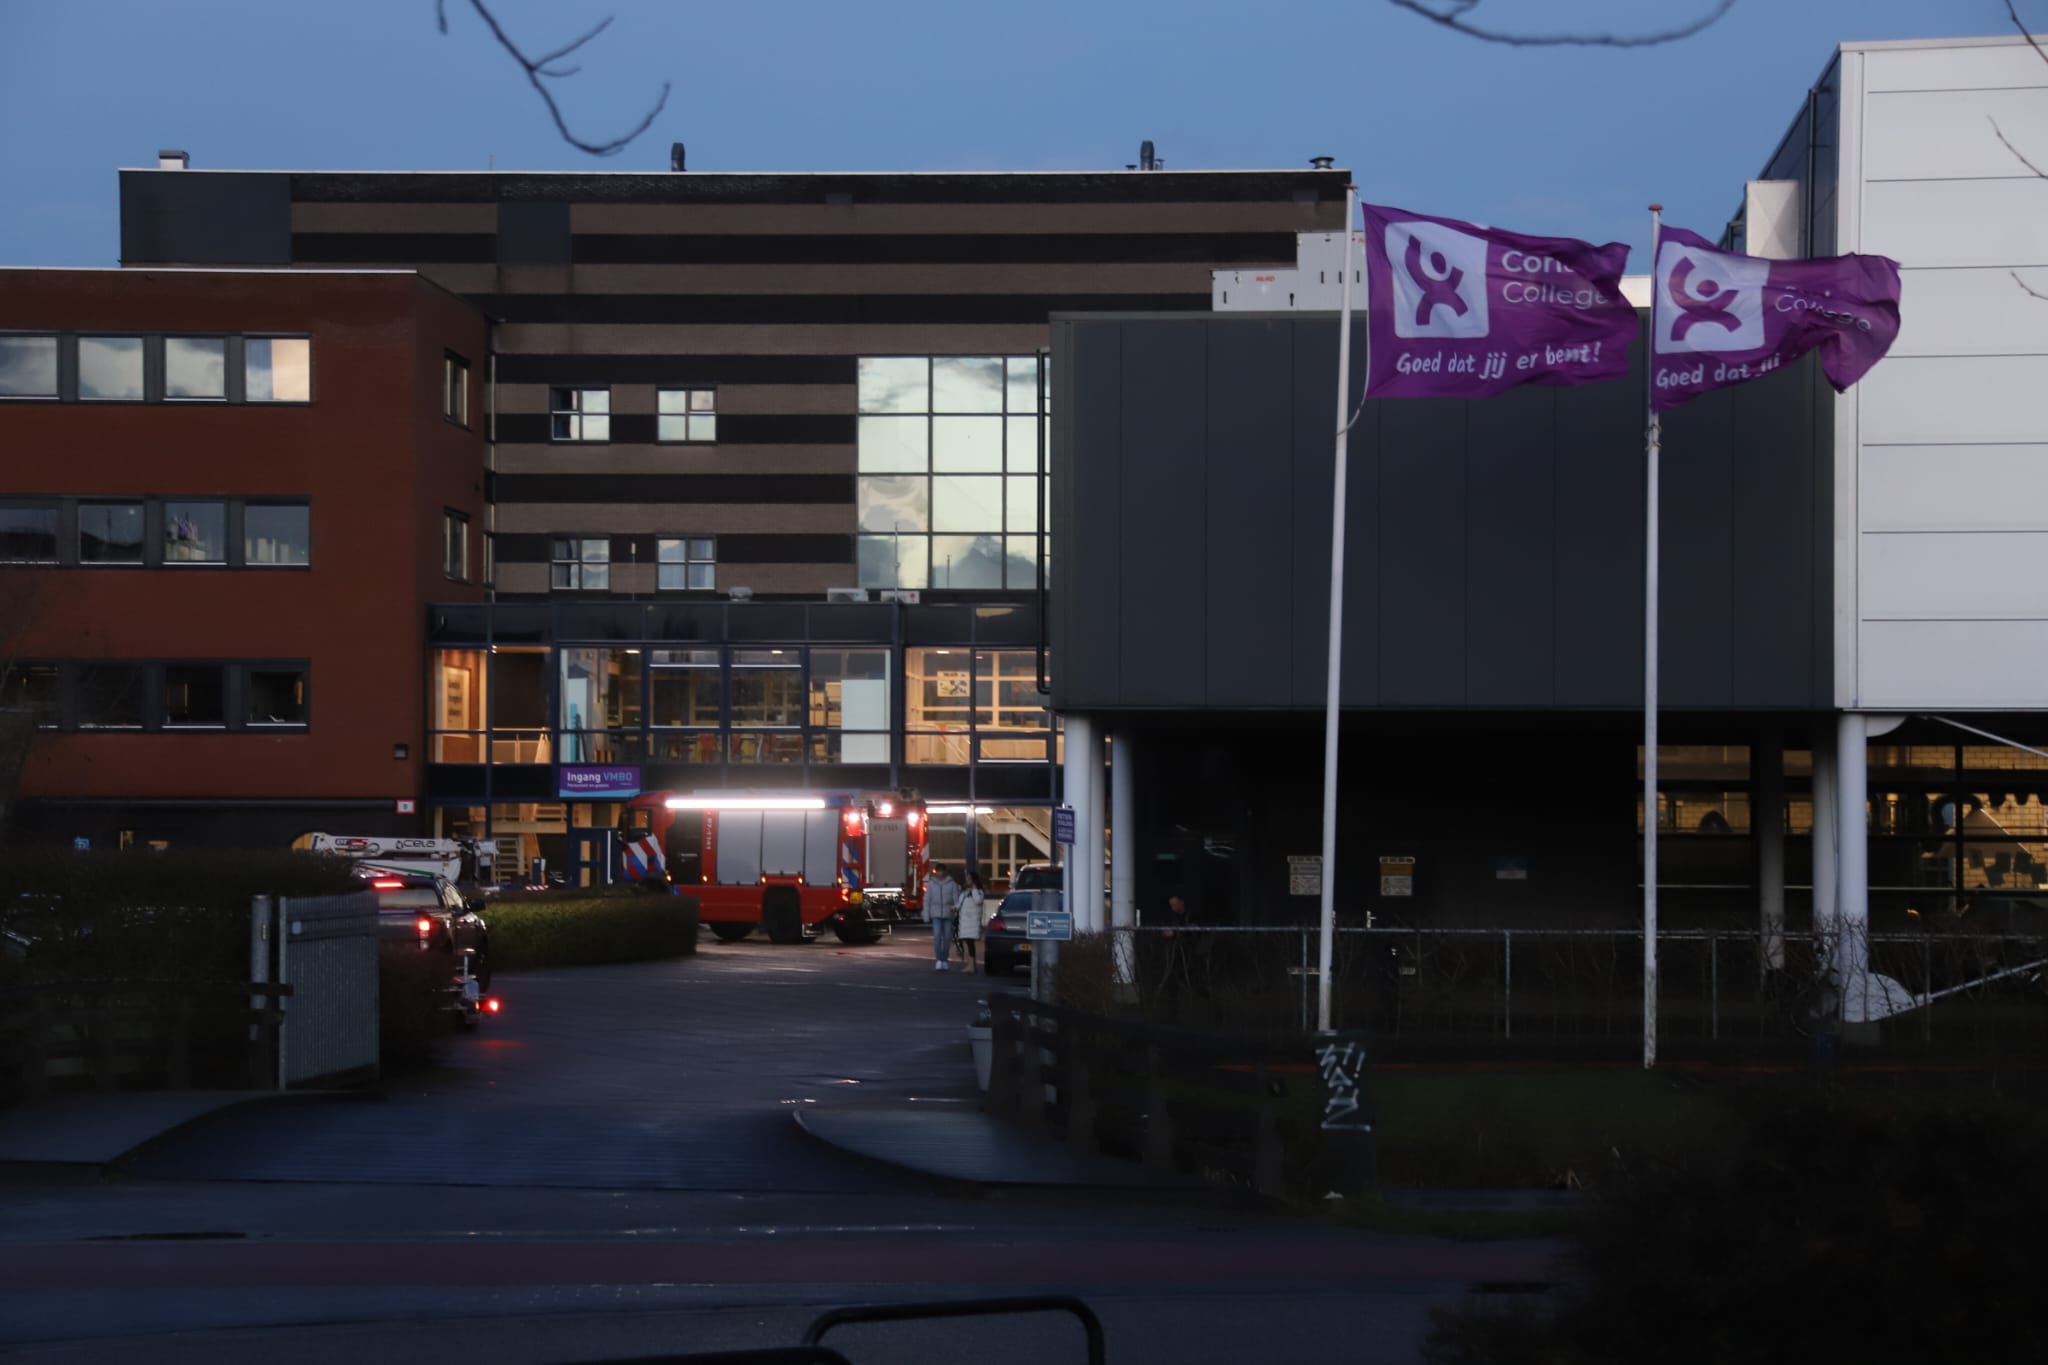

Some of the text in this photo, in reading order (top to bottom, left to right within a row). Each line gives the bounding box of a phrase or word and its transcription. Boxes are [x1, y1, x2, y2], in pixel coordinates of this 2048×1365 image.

[1503, 281, 1609, 310] College
[1396, 351, 1442, 375] Goed
[1448, 351, 1476, 373] dat
[1478, 352, 1508, 380] jij
[1516, 353, 1539, 370] er
[1656, 363, 1704, 389] Goed
[1714, 362, 1752, 383] dat
[567, 772, 633, 784] Ingang VMBO
